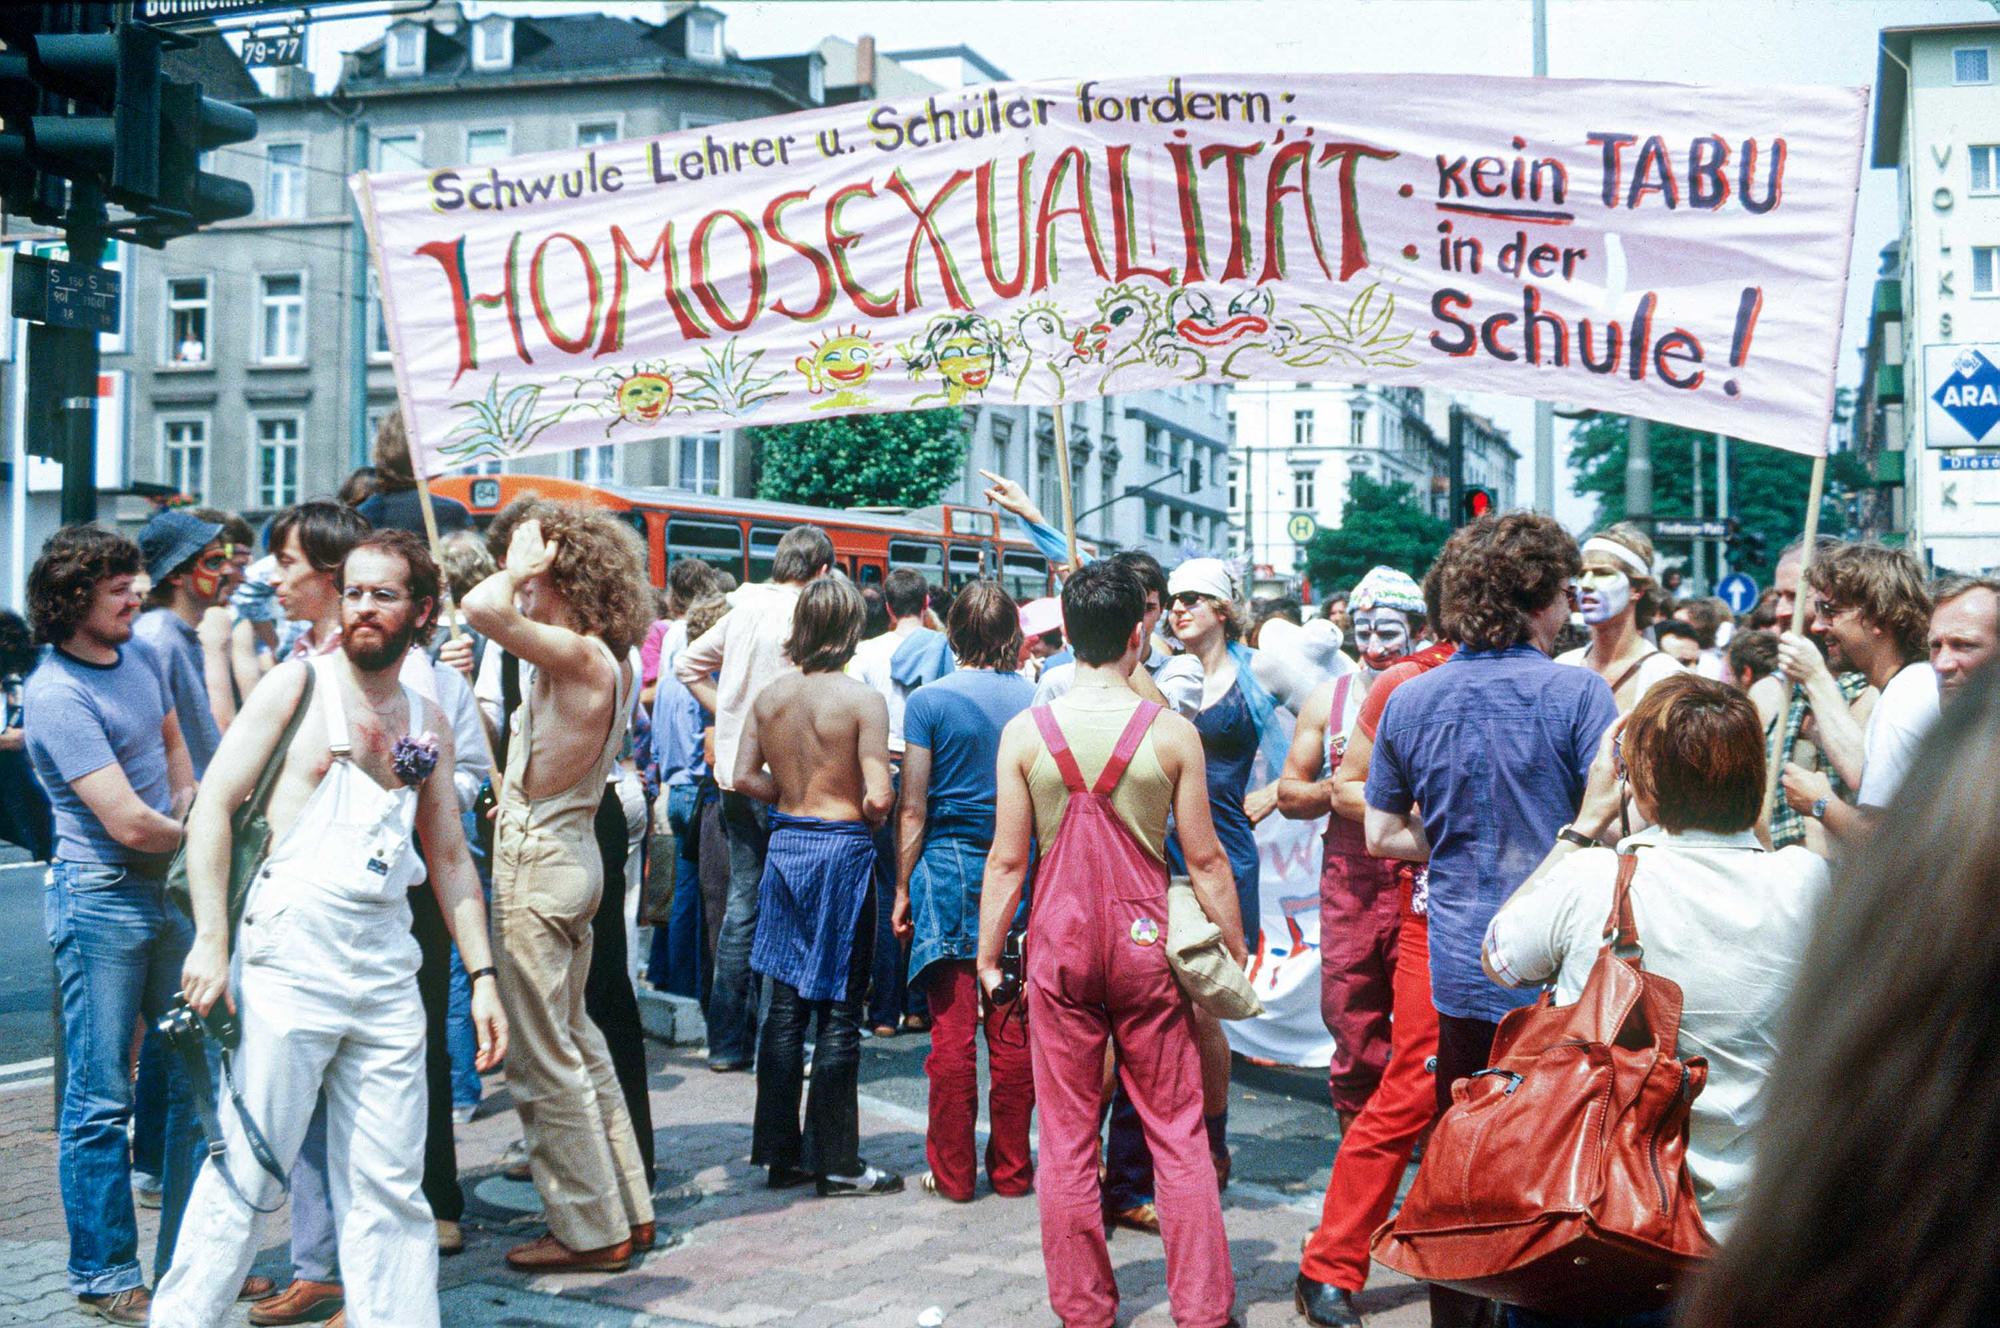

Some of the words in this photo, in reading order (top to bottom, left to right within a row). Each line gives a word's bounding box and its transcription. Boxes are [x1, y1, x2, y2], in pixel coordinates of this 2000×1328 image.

[244, 38, 299, 64] 79-77
[428, 151, 624, 212] Schwule
[647, 135, 796, 184] Lehrer
[817, 127, 856, 158] u.
[870, 88, 1056, 152] Schüler
[1076, 78, 1296, 124] fordern:
[1587, 132, 1788, 215] TABU
[1437, 219, 1483, 275] in
[1498, 231, 1588, 282] der
[1429, 285, 1763, 397] Schule!
[1942, 384, 2000, 407] ARA
[1951, 456, 2000, 469] Diese
[1296, 520, 1309, 536] H
